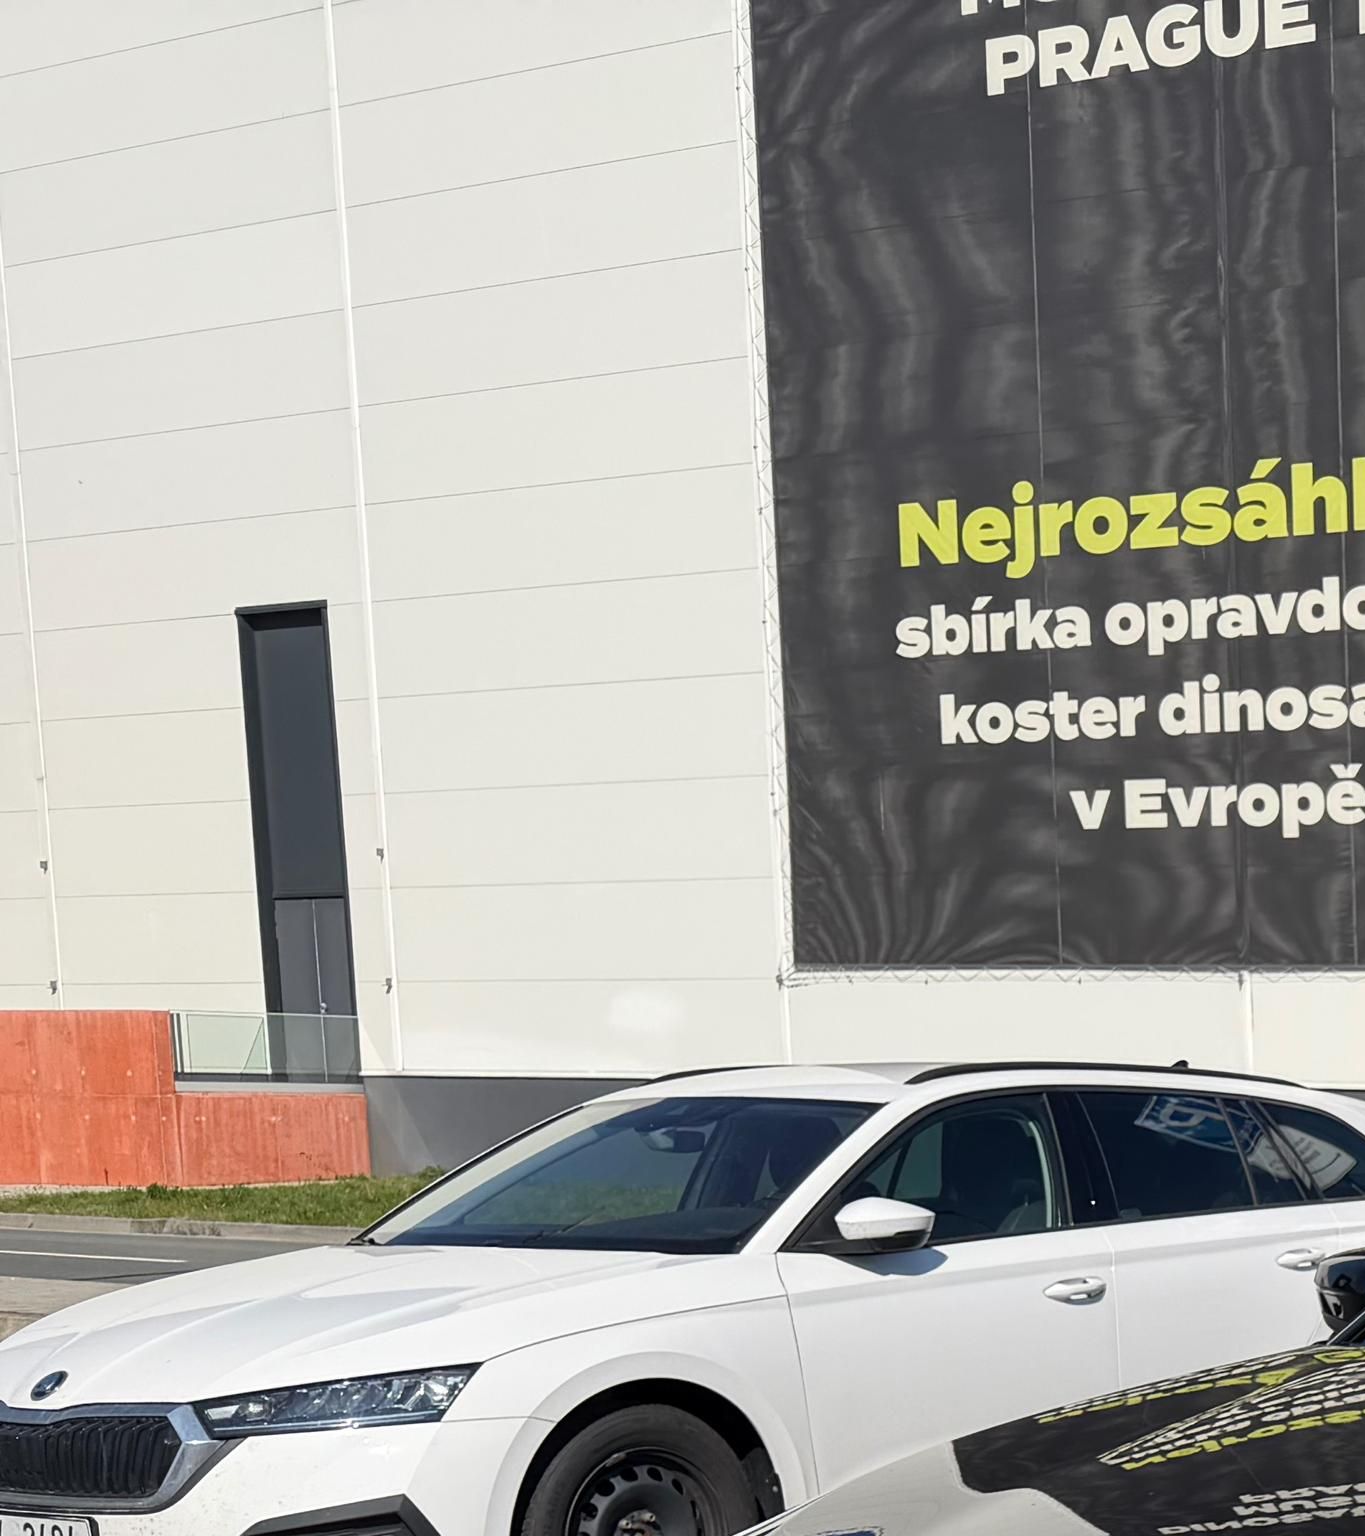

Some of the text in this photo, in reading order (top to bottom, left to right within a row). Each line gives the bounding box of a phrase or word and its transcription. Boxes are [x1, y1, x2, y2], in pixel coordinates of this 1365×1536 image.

[985, 0, 1316, 96] PRAGUE
[895, 596, 1092, 659] sbírka
[939, 693, 1146, 745] koster
[1070, 788, 1111, 831] v
